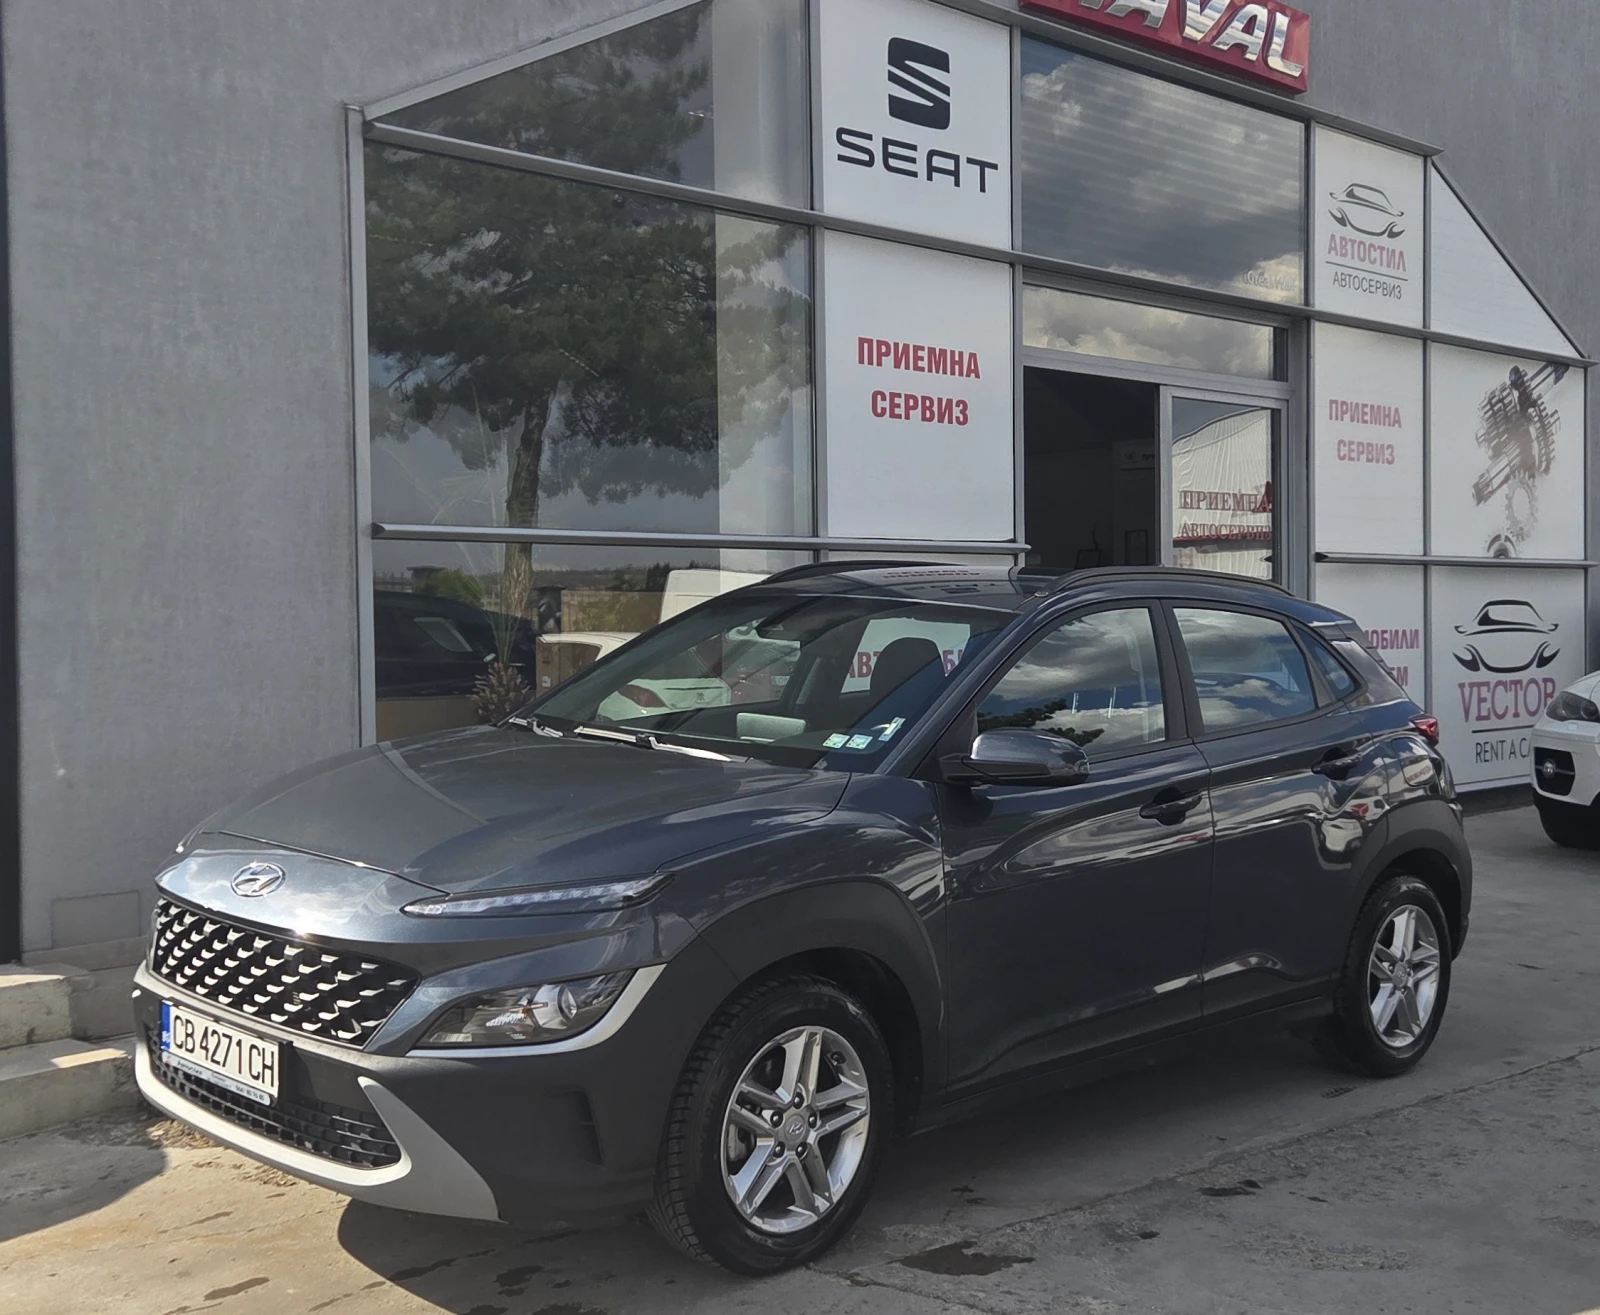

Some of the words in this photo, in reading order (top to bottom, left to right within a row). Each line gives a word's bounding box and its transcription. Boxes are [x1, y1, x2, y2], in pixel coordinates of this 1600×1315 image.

[836, 127, 999, 193] SEAT
[1327, 233, 1407, 272] АВТОСТИЛ
[1332, 271, 1403, 300] АВТОСЕРВИЗ
[857, 336, 981, 379] ПРИЕМНА
[871, 389, 969, 426] СЕРВИЗ
[1328, 399, 1402, 428] ПРИЕМНА
[1336, 439, 1395, 466] СЕРВИЗ
[1363, 629, 1420, 651] ОБИЛИ
[1475, 740, 1506, 763] RENT
[1508, 739, 1517, 760] A
[173, 1014, 196, 1054] CB
[199, 1026, 243, 1075] 4271
[248, 1043, 275, 1088] CH
